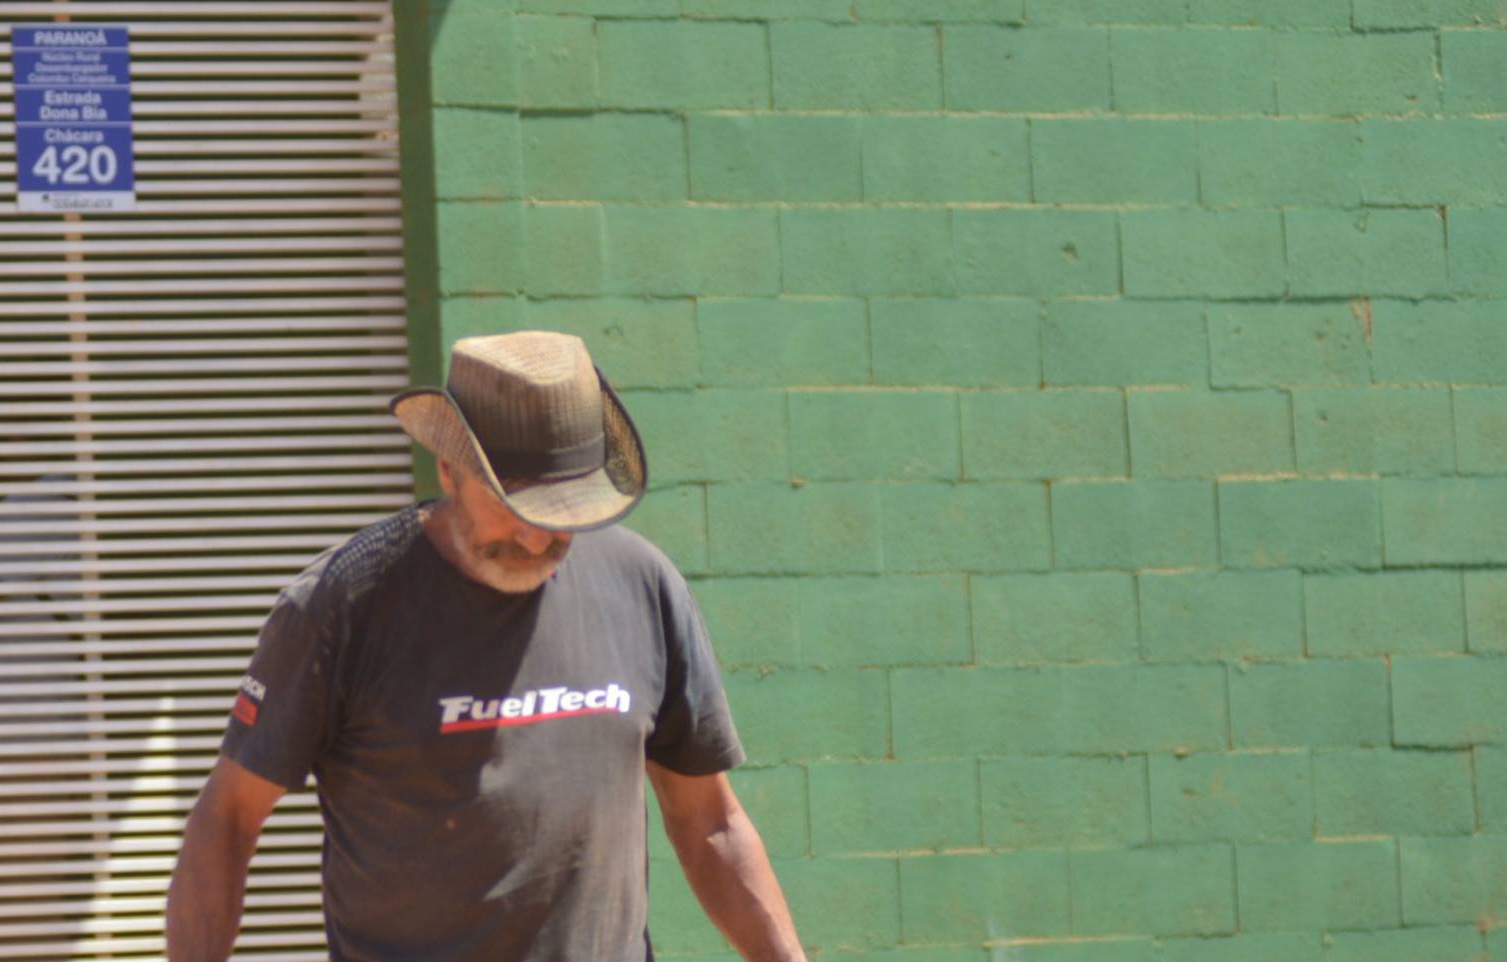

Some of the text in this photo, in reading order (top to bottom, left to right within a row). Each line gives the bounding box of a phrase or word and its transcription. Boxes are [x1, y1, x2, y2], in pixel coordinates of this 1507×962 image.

[34, 30, 107, 45] PARANOÁ
[44, 90, 102, 105] Estrada
[40, 106, 79, 120] Dona
[45, 128, 104, 143] Chácara
[32, 145, 117, 184] 420
[439, 683, 631, 724] FuelTech
